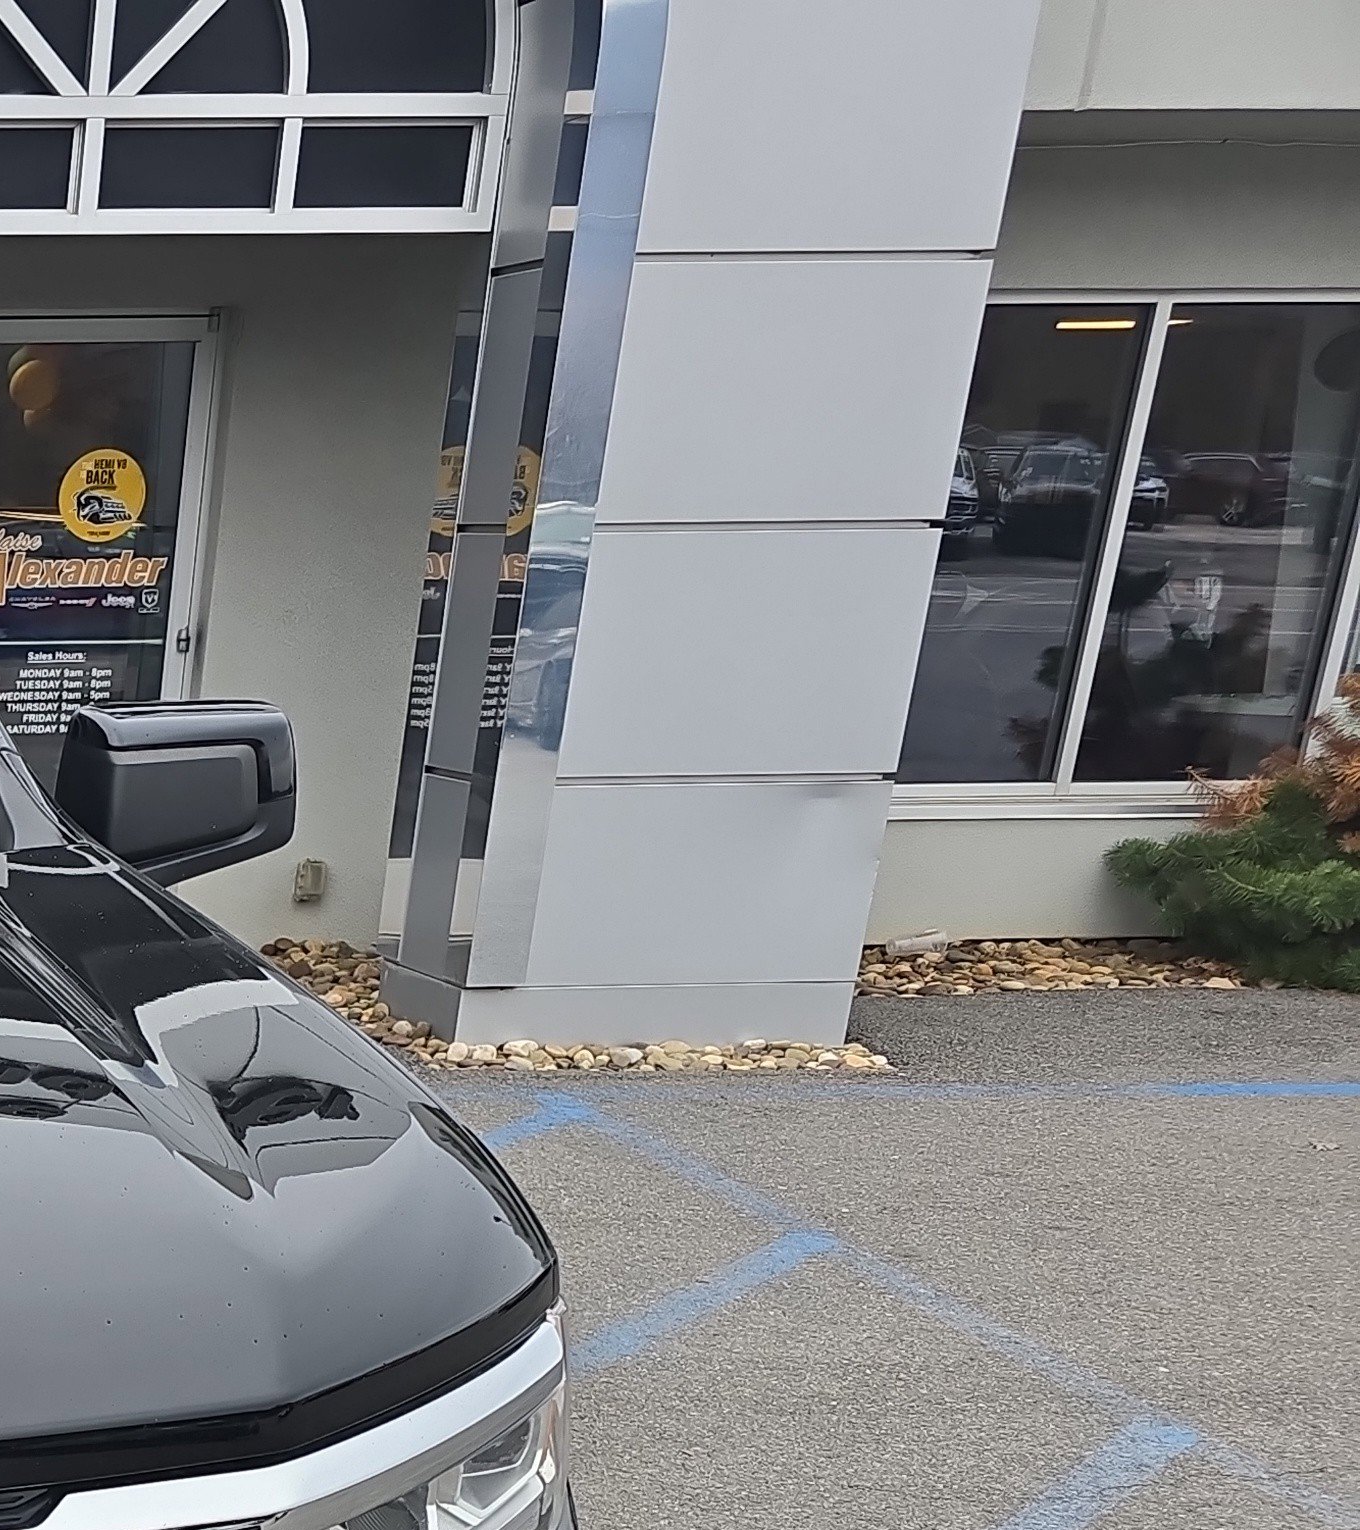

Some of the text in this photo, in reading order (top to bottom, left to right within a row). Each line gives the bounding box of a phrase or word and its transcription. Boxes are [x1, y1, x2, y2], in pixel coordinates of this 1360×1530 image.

[85, 470, 116, 484] BACK
[101, 593, 136, 608] Jeep
[27, 651, 53, 660] Sales
[19, 668, 61, 678] MONDAY
[63, 668, 84, 677] 9am
[91, 668, 112, 678] 8pm
[15, 680, 61, 689] TUESDAY
[62, 680, 83, 689] 9am
[90, 679, 111, 689] 8pm
[61, 691, 82, 700] 9am
[6, 703, 59, 712] THURSDAY
[22, 714, 58, 723] FRIDAY
[6, 725, 58, 734] SATURDAY
